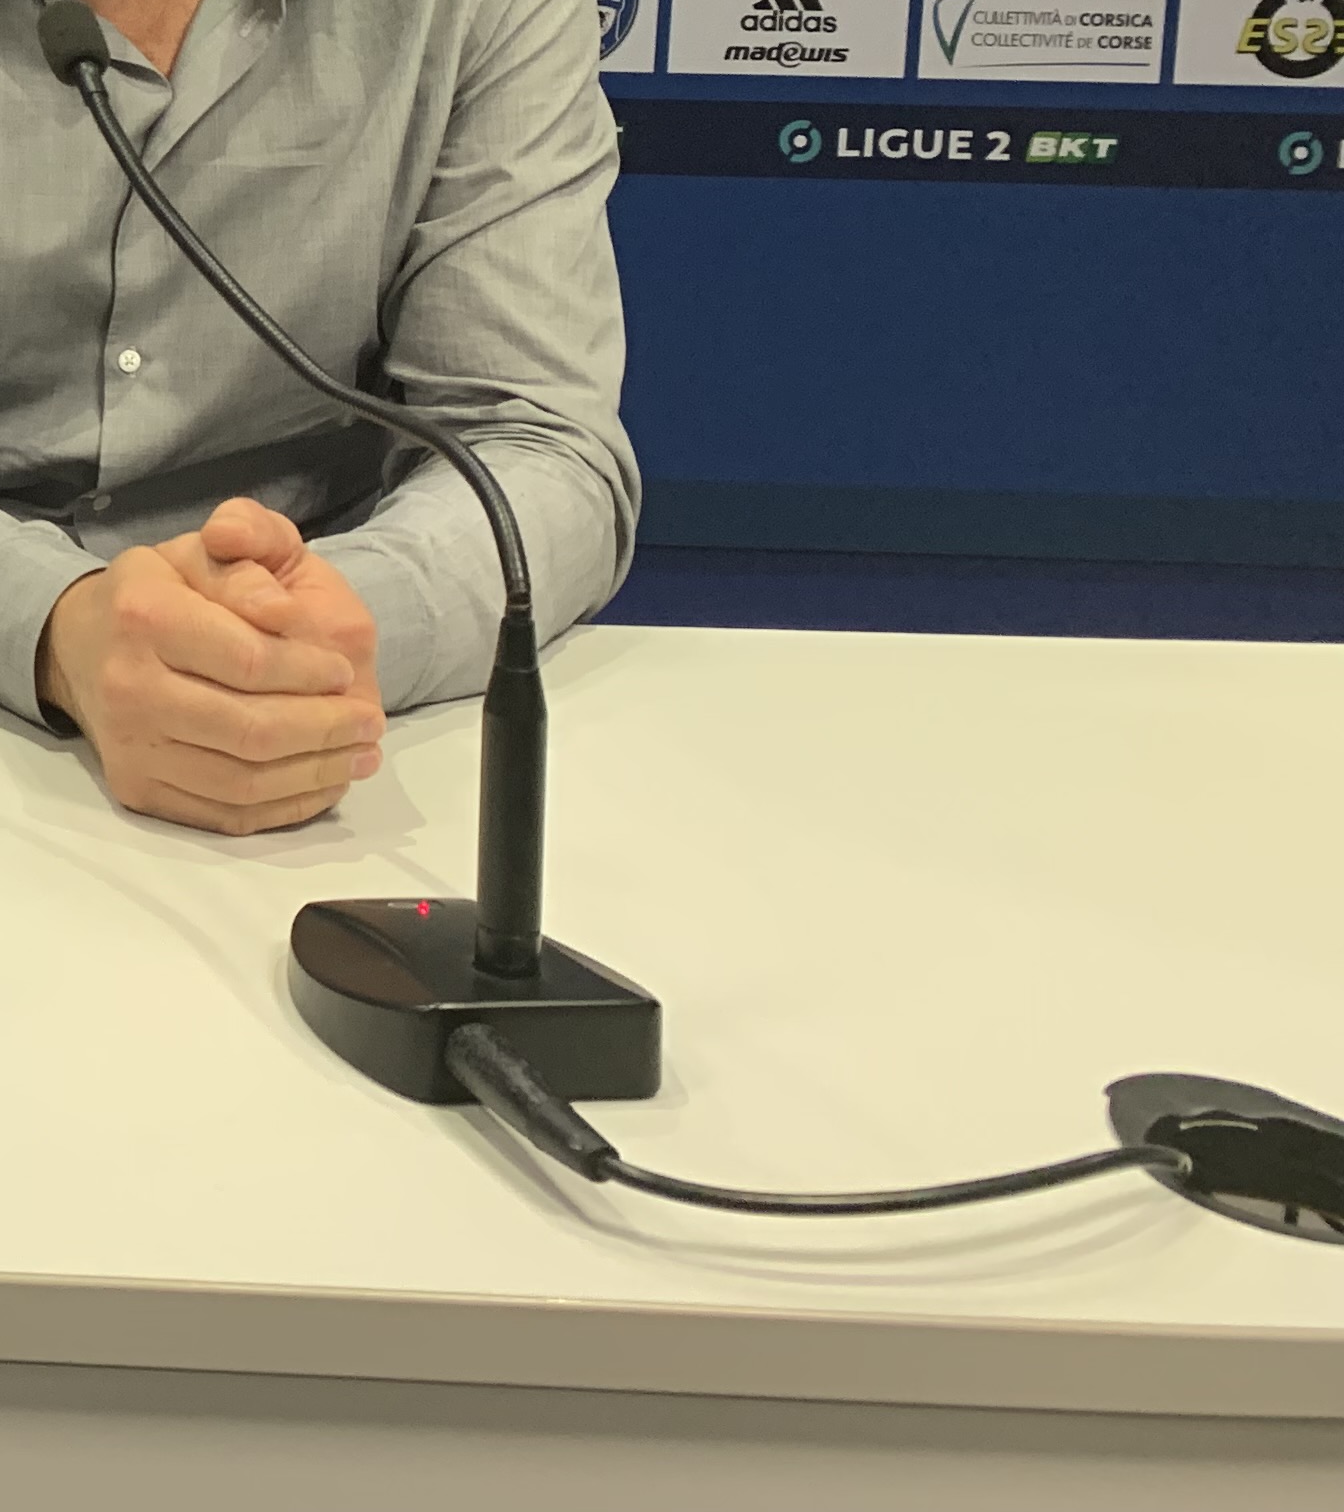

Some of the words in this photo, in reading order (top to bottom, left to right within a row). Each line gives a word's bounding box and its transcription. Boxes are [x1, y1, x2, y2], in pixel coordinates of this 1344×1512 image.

[740, 10, 838, 33] adidas
[837, 128, 974, 160] LIGUE
[986, 131, 1011, 161] 2
[1028, 136, 1118, 158] BKT
